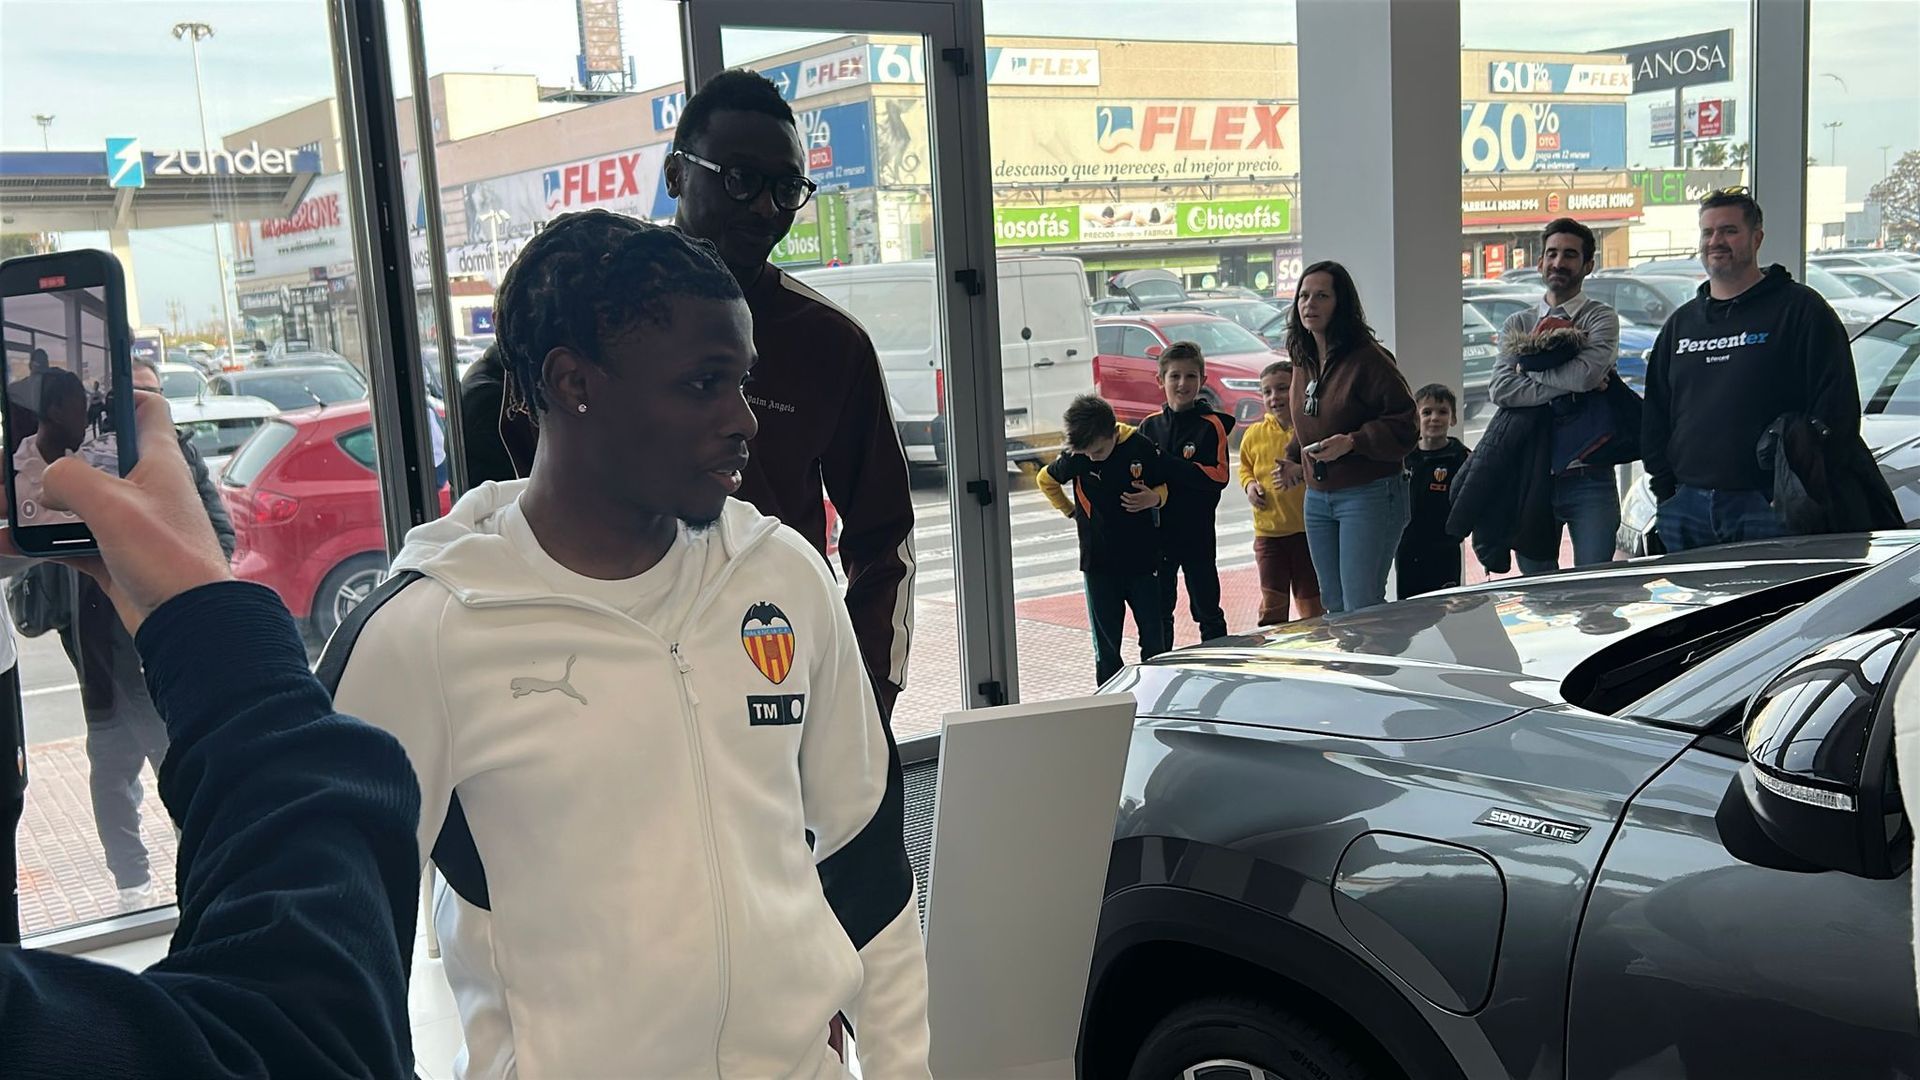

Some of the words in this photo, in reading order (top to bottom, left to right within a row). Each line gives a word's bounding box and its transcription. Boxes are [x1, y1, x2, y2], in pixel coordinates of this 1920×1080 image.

[818, 56, 863, 85] FLEX
[1029, 58, 1091, 75] FLEX
[1632, 45, 1726, 81] ANOSA
[1590, 73, 1629, 87] FLEX
[1139, 106, 1290, 151] FLEX
[1539, 136, 1557, 146] DTO.
[153, 140, 299, 175] zunder
[1561, 150, 1569, 159] 12
[564, 153, 640, 207] FLEX
[995, 160, 1067, 177] descanso
[1072, 164, 1100, 180] que
[1104, 162, 1169, 177] mereces,
[1173, 157, 1188, 174] al
[1191, 156, 1234, 177] mejor
[1236, 156, 1282, 177] precio.
[1568, 194, 1608, 209] BURGER
[1608, 193, 1634, 208] KING
[995, 211, 1070, 240] iosofás
[1206, 204, 1281, 230] biosofás
[1676, 331, 1769, 354] Percenter
[747, 395, 767, 407] Palm
[768, 400, 795, 413] Angels
[753, 703, 778, 719] TM
[1490, 810, 1540, 829] SPORT
[1541, 825, 1574, 840] LINE
